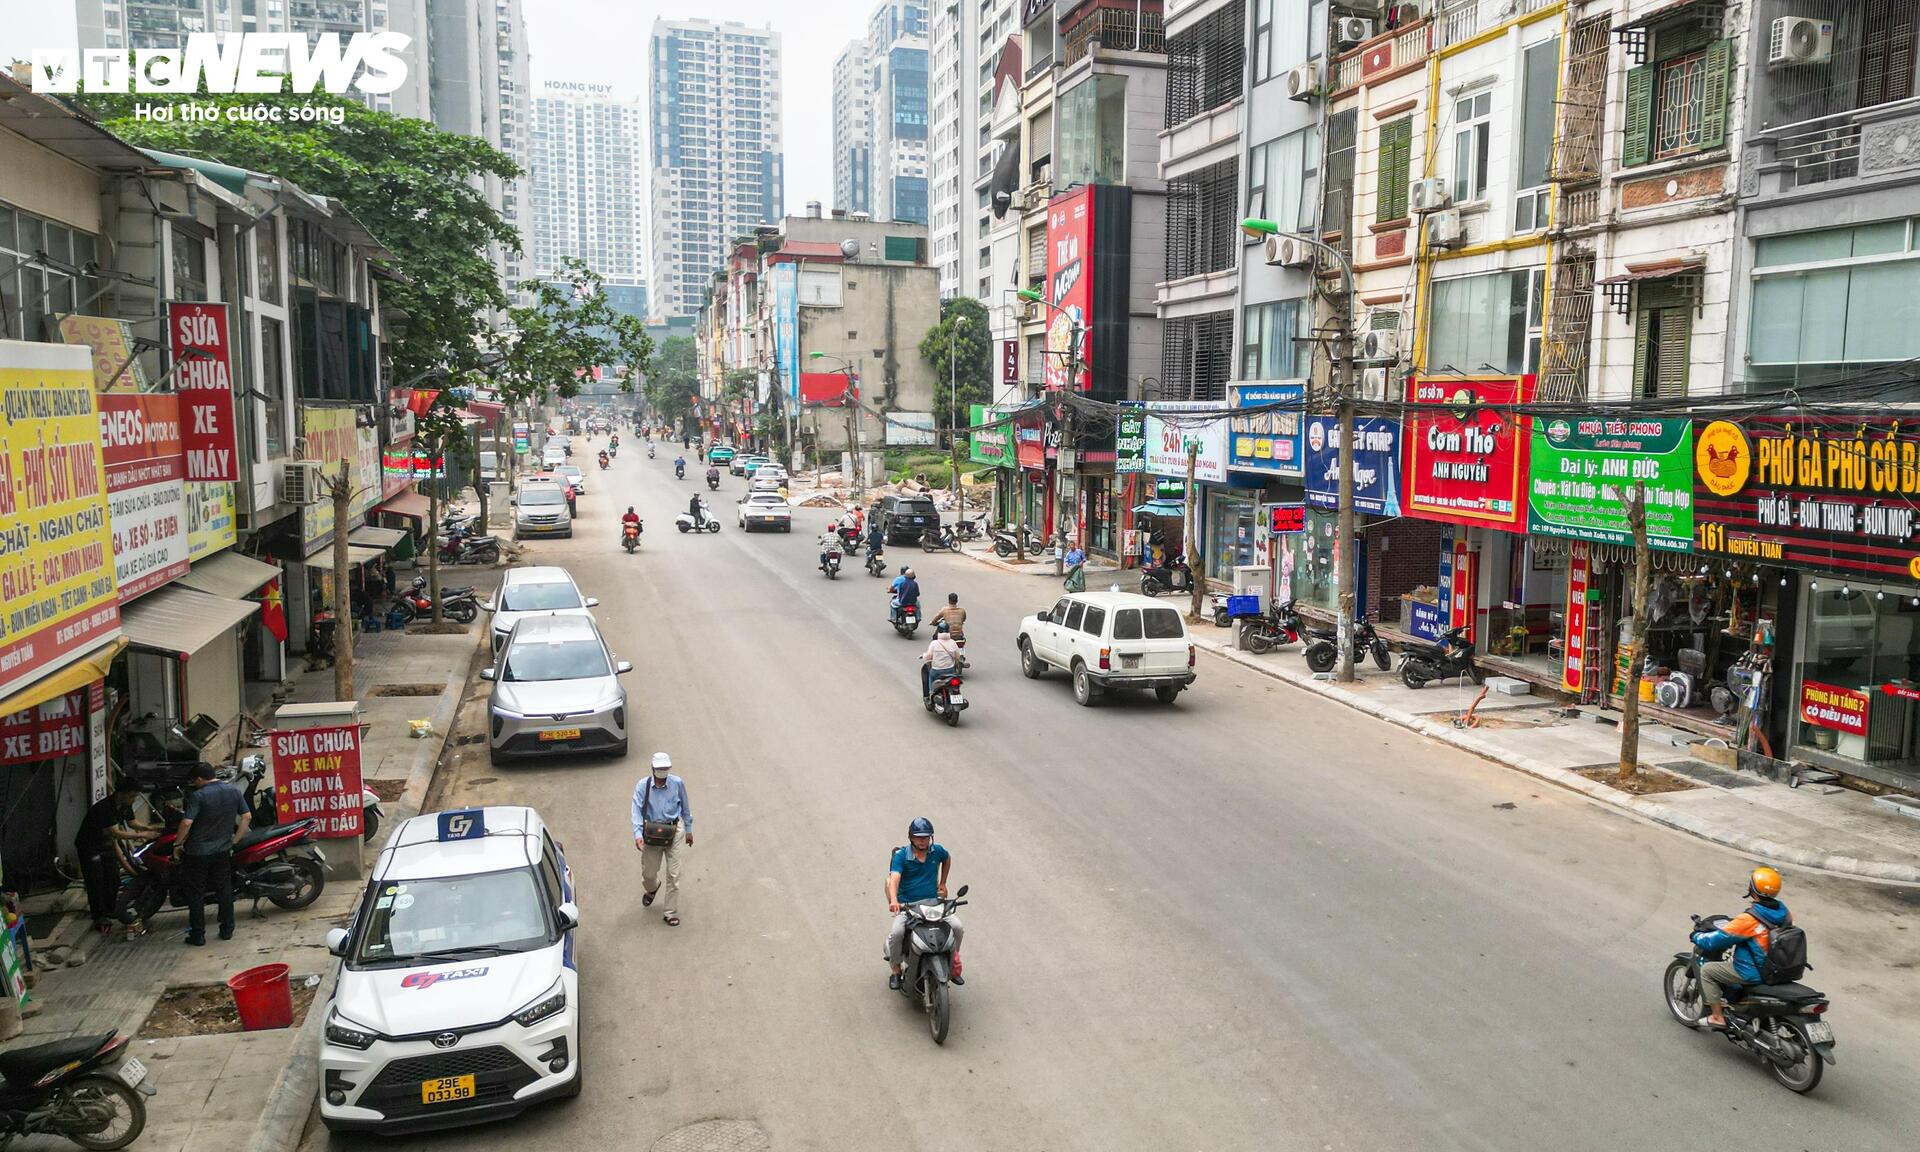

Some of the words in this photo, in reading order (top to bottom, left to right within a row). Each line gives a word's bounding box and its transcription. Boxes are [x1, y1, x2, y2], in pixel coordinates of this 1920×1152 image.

[588, 84, 613, 93] HUY
[178, 306, 220, 346] SỬA
[1418, 387, 1427, 399] CƠ
[1428, 384, 1436, 399] SỞ
[1437, 387, 1444, 399] 70
[4, 381, 28, 427] QUÁN
[99, 409, 143, 448] ENEOS
[145, 421, 168, 443] MOTOR
[169, 421, 179, 441] OIL
[192, 405, 219, 434] XE
[1578, 420, 1602, 438] NHỰA
[1629, 422, 1662, 437] PHONG
[1163, 432, 1181, 453] 24h
[1366, 425, 1393, 451] PHÁP
[1428, 424, 1460, 452] Cơm
[1465, 423, 1500, 454] Thố
[23, 428, 48, 509] PHỞ
[48, 425, 70, 504] SỐT
[69, 442, 99, 498] VANG
[186, 443, 230, 478] MÁY
[1560, 457, 1580, 478] Đại
[1584, 458, 1598, 479] lý:
[1601, 458, 1628, 477] ANH
[1632, 456, 1659, 479] ĐỨC
[1759, 422, 1794, 486] PHỞ
[1798, 428, 1823, 487] GÀ
[1827, 422, 1866, 490] PHỐ
[1870, 420, 1898, 493] CỔ
[112, 470, 128, 488] MẠNH
[128, 464, 138, 484] DẦU
[1432, 461, 1449, 479] ANH
[113, 497, 124, 517] TÂM
[125, 494, 136, 515] SỬA
[1534, 478, 1556, 497] Chuyên
[1560, 480, 1571, 500] Vật
[1581, 482, 1596, 502] Điện
[1655, 484, 1673, 507] Tổng
[1675, 489, 1690, 510] Hợp
[39, 515, 73, 543] NGAN
[76, 503, 104, 533] CHẶT
[1758, 490, 1776, 525] PHỞ
[1778, 493, 1790, 526] GÀ
[1800, 496, 1819, 529] BÚN
[1822, 503, 1854, 532] THANG
[1864, 501, 1886, 535] BÚN
[1888, 508, 1912, 544] MỌC
[112, 531, 123, 556] GA
[129, 525, 139, 551] XE
[140, 519, 149, 545] SỐ
[154, 519, 163, 542] XE
[1550, 525, 1566, 535] Nguyễn
[1578, 529, 1592, 538] Thanh
[1615, 534, 1624, 543] Nội
[1700, 523, 1724, 552] 161
[1728, 535, 1759, 556] NGUYỄN
[1761, 540, 1782, 559] TUÂN
[2, 565, 16, 601] GÀ
[17, 559, 29, 596] LÁ
[44, 551, 60, 586] CÁC
[61, 545, 81, 580] MÓN
[82, 539, 104, 574] NHẬU
[117, 564, 129, 580] MUA
[130, 560, 138, 577] XE
[139, 552, 147, 573] CŨ
[147, 551, 156, 571] GIÁ
[157, 548, 168, 565] CAO
[1572, 568, 1585, 583] SINH
[1572, 589, 1585, 604] VIÊN
[1574, 613, 1579, 626] &
[1571, 634, 1581, 649] GIA
[1805, 687, 1828, 703] PHÒNG
[1829, 690, 1839, 706] ĂN
[1858, 700, 1864, 712] 2
[1806, 703, 1819, 716] CÓ
[1819, 706, 1840, 722] ĐIỀU
[1841, 713, 1862, 727] HOÀ
[4, 735, 32, 759] XE
[39, 724, 85, 754] ĐIỆN
[277, 729, 309, 757] SỬA
[313, 728, 355, 754] CHỮA
[95, 765, 104, 780] XE
[293, 758, 310, 774] XE
[314, 754, 342, 771] MÁY
[95, 786, 105, 801] GA
[291, 776, 322, 794] BƠM
[326, 772, 344, 791] VÁ
[293, 796, 325, 813] THAY
[330, 791, 360, 811] SĂM
[313, 818, 327, 833] AY
[331, 811, 358, 832] DẦU
[449, 814, 473, 837] G7
[401, 971, 441, 990] G7
[441, 967, 488, 980] TAXI
[428, 1087, 469, 1102] 033.98
[437, 1077, 460, 1090] 29E
